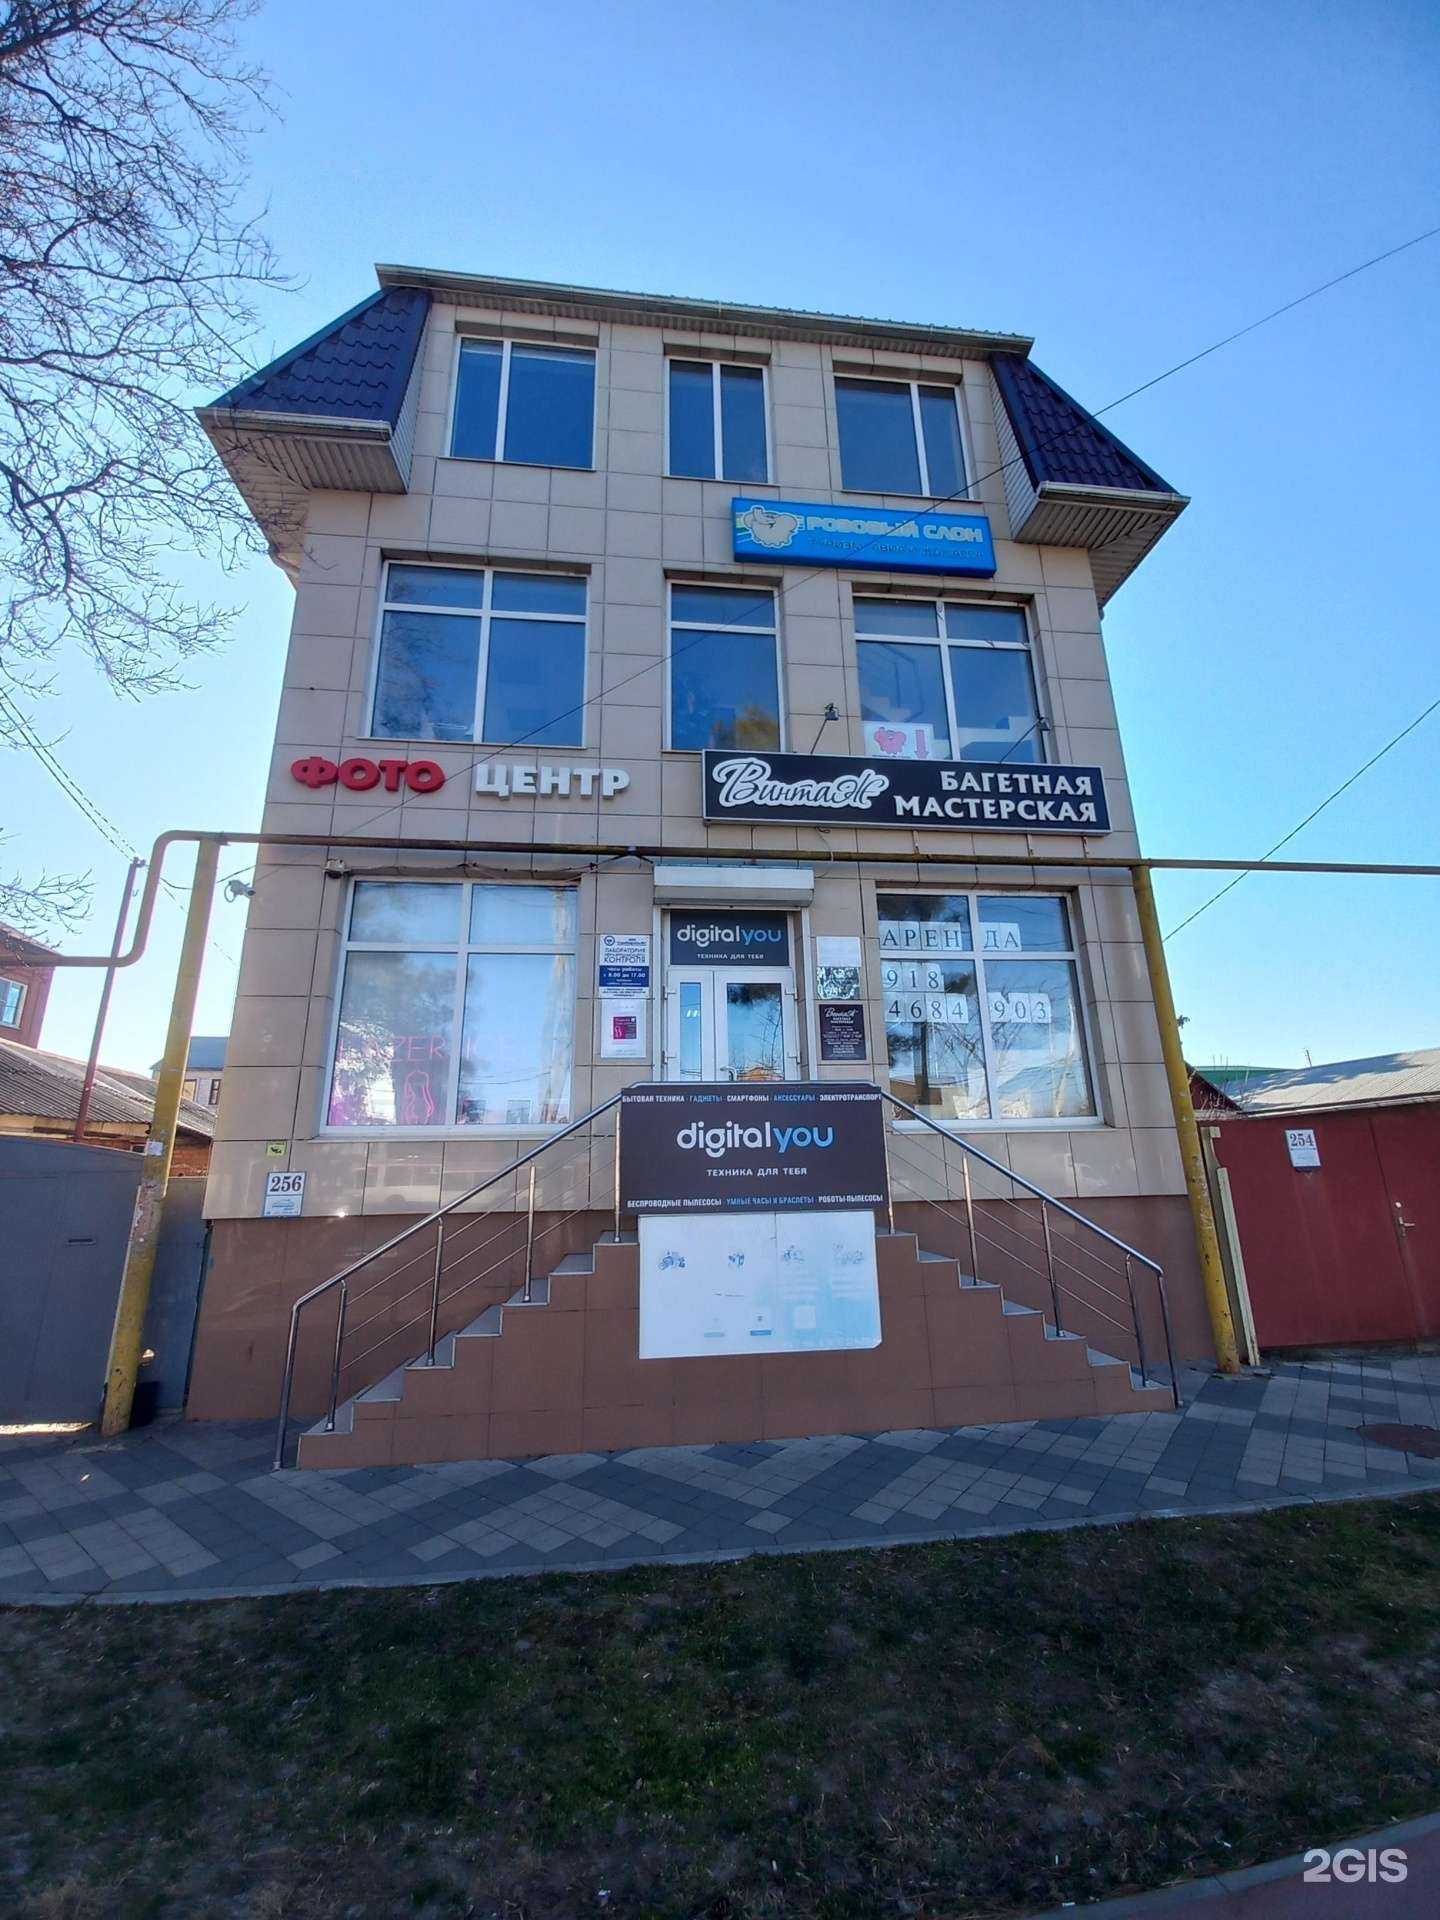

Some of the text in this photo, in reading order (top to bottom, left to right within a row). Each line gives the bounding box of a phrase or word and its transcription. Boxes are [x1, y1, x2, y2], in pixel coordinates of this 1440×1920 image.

[923, 524, 984, 543] СЛОН
[290, 756, 631, 801] ФОТО ЦЕНТР
[940, 770, 1093, 797] БАГЕТНАЯ
[893, 795, 1097, 823] МАСТЕРСКАЯ
[696, 952, 765, 960] ТЕХНИКА ДЛЯ ТЕБЯ
[886, 968, 941, 989] 918
[655, 1095, 685, 1103] ТЕХНИКА
[726, 1094, 770, 1103] СМАРТФОНЫ
[773, 1094, 816, 1102] АКСЕССУАРЫ
[1289, 1132, 1315, 1147] 254
[706, 1167, 808, 1178] ТЕХНИКА ДЛЯ ТЕБЯ
[269, 1175, 303, 1193] 256
[626, 1199, 682, 1208] БЕСПРОВОДНЫЕ
[682, 1198, 722, 1207] ПЫЛЕСОСЫ
[778, 1195, 815, 1204] БРАСЛЕТЫ
